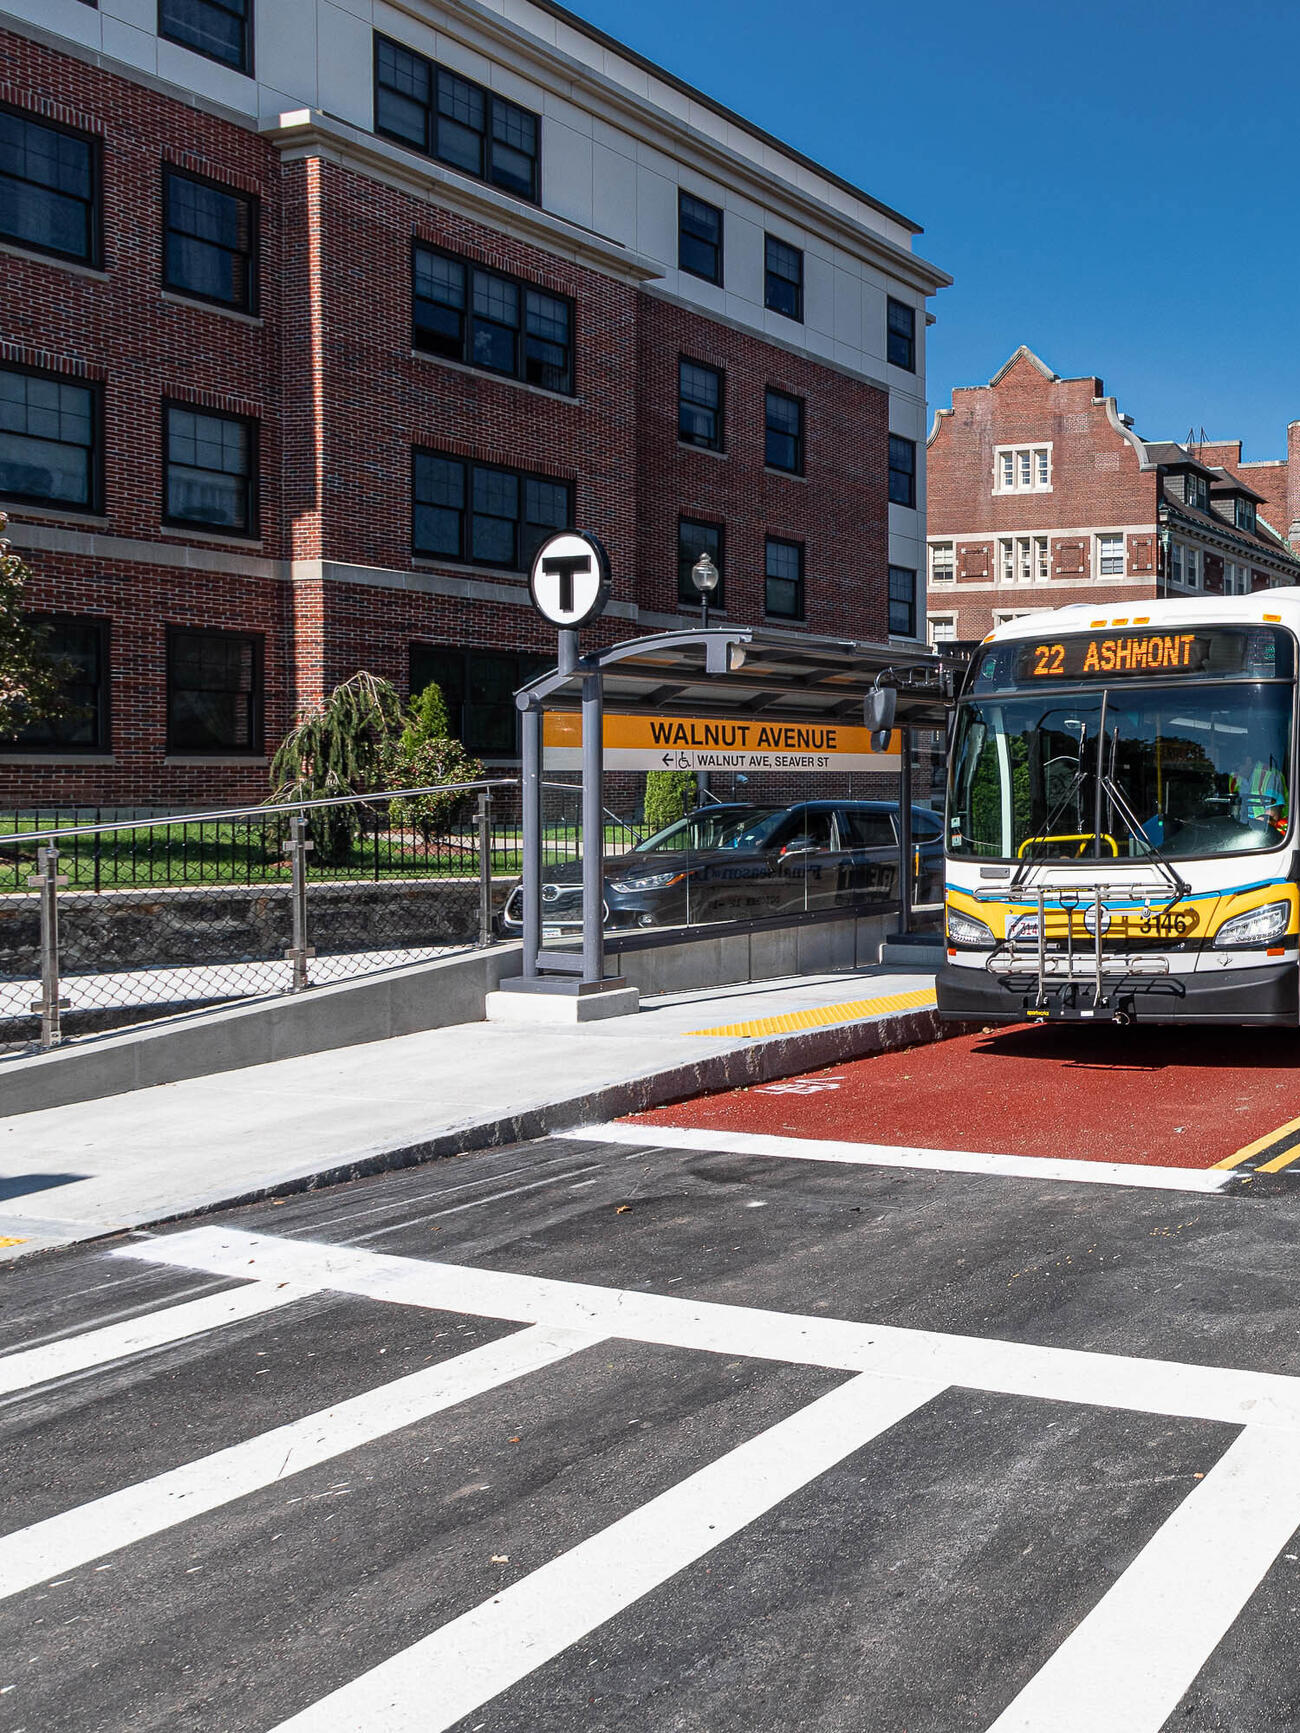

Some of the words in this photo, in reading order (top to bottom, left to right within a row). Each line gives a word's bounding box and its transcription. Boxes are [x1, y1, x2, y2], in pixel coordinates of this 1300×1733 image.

[542, 554, 592, 612] T
[1033, 644, 1065, 675] 22
[1083, 634, 1196, 672] ASHMONT
[650, 721, 750, 747] WALNUT
[757, 727, 837, 749] AVENUE
[697, 754, 746, 767] WALNUT
[750, 756, 772, 769] AVE,
[775, 756, 814, 768] SEAVER
[817, 756, 830, 768] ST
[1140, 912, 1187, 934] 3146
